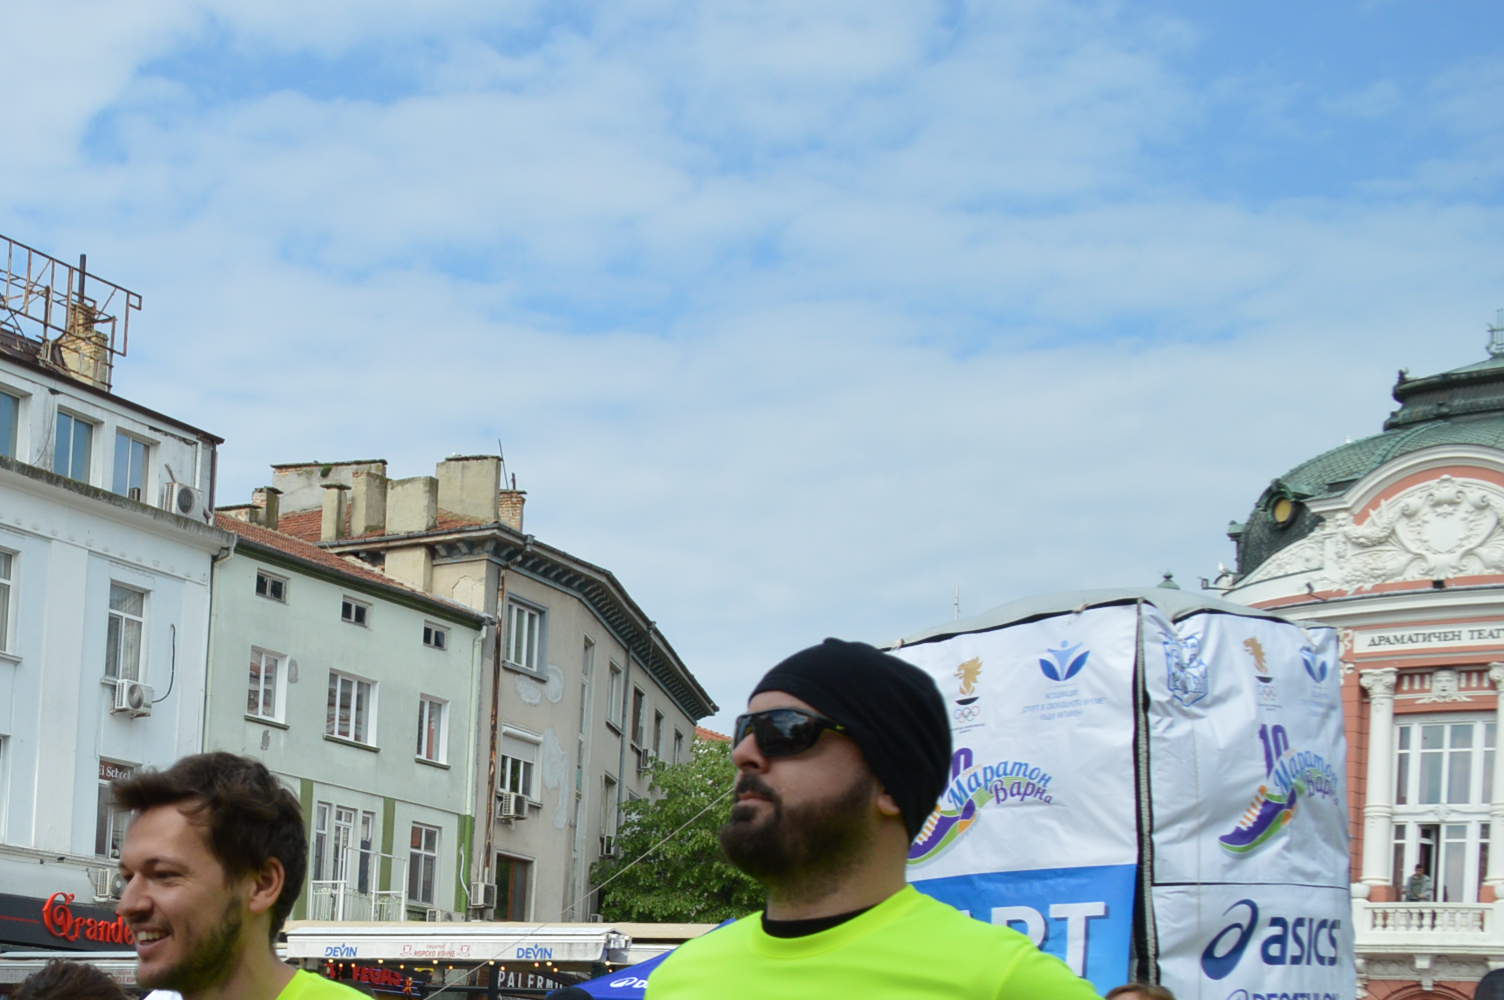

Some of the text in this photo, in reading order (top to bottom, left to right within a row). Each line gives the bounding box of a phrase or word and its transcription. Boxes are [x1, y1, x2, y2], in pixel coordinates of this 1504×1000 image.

[1367, 630, 1462, 647] ДРАМАТИЧЕН
[947, 761, 1053, 812] Маратон
[989, 779, 1054, 804] Варна
[42, 891, 136, 943] Grande
[324, 946, 359, 957] DEVIN
[960, 901, 1106, 977] RT
[1260, 915, 1341, 967] asics
[516, 947, 553, 959] DEVIN
[497, 969, 563, 989] PALERM
